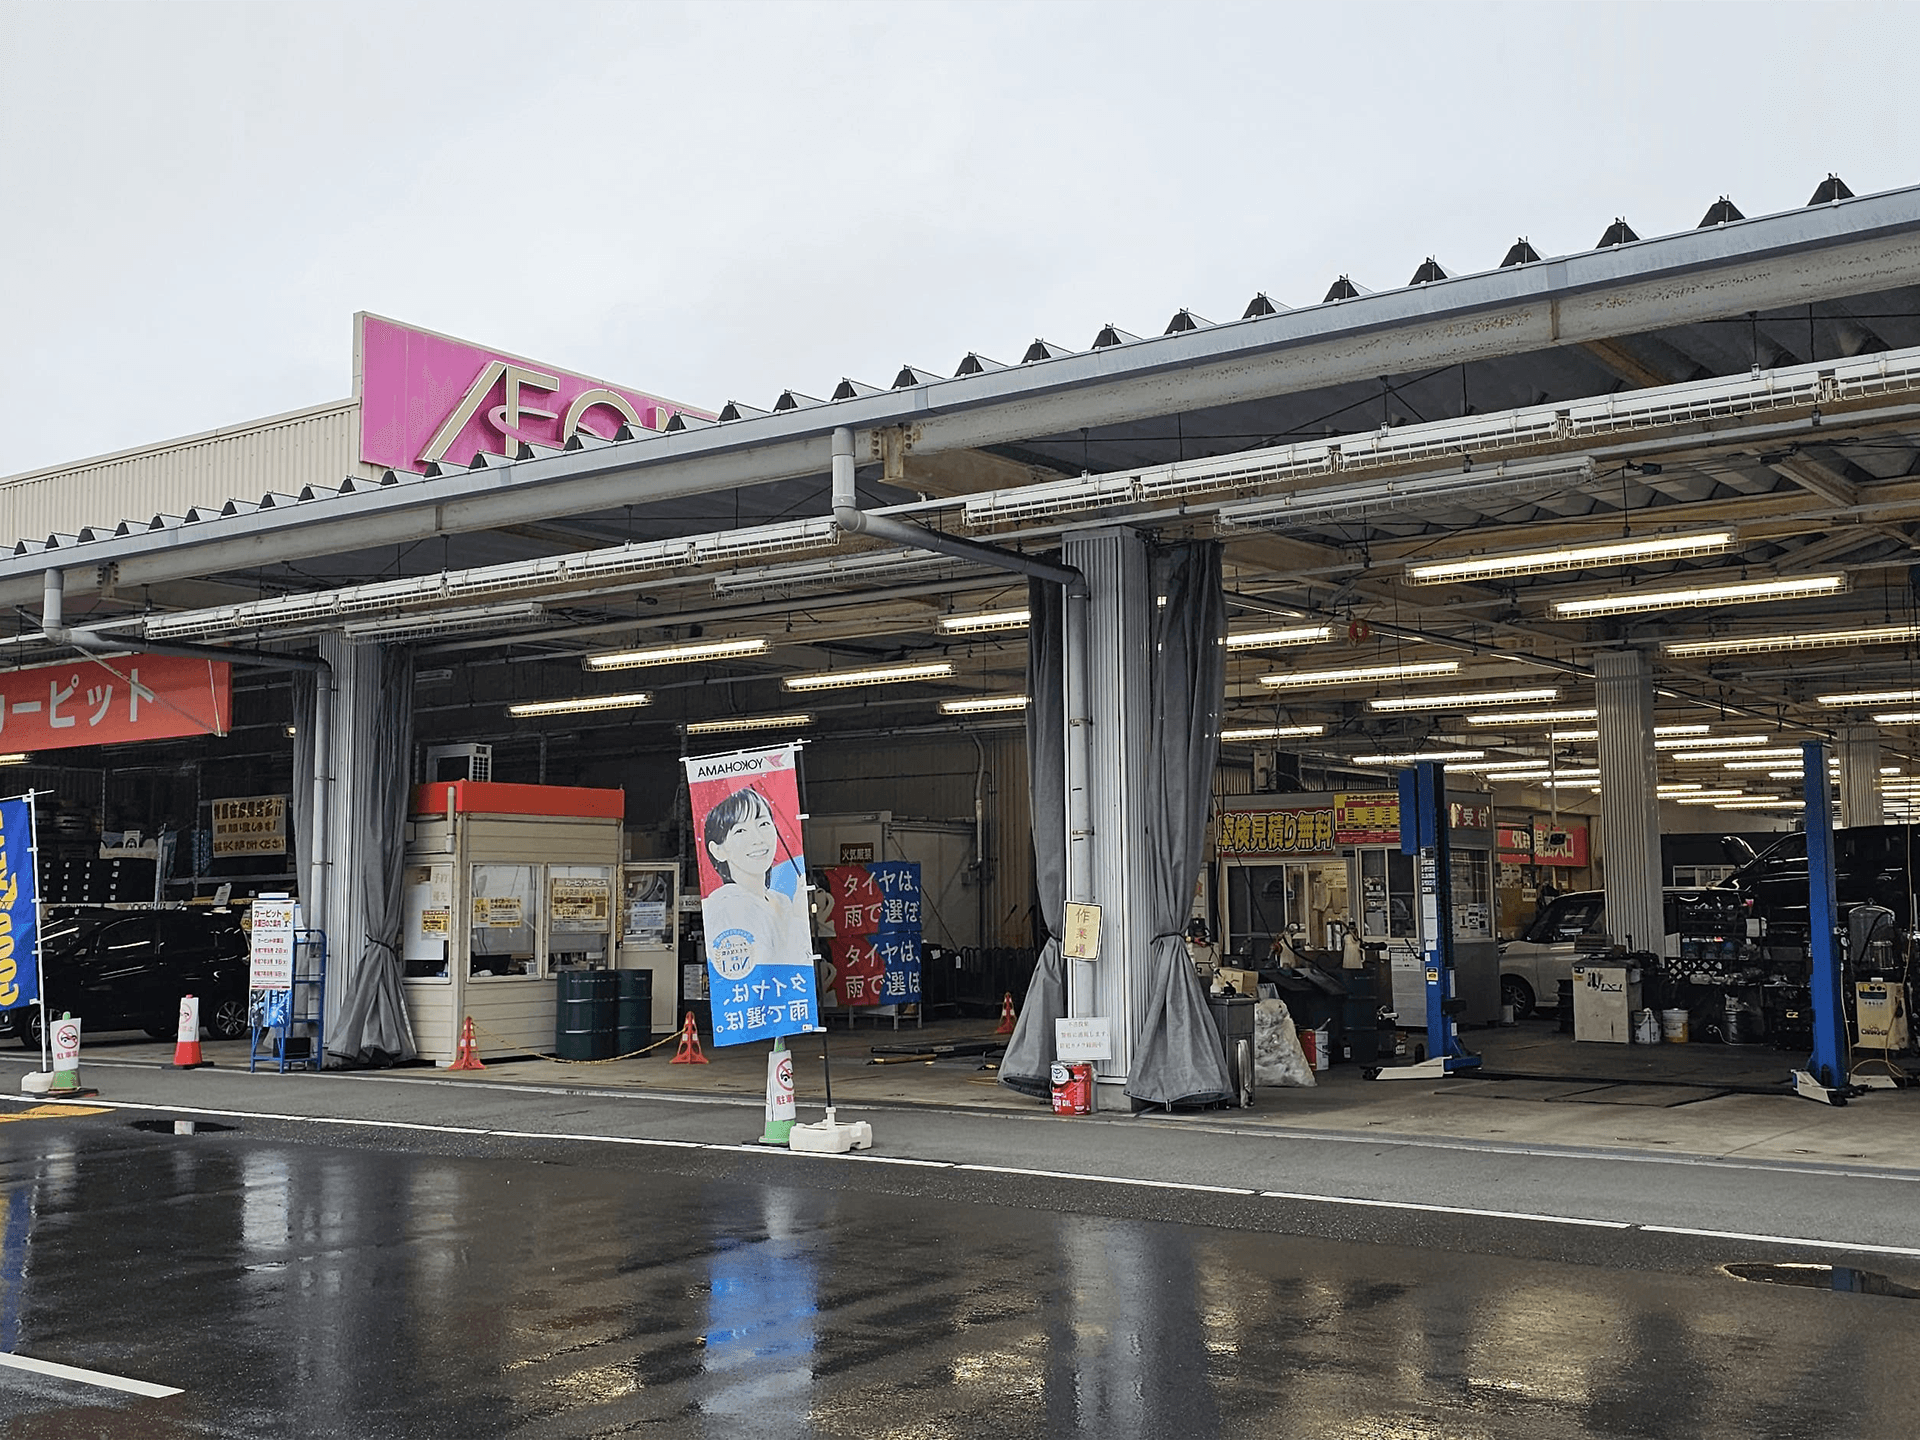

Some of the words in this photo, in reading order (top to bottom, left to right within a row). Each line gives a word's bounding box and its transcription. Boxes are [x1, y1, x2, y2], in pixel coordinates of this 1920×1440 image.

[0, 669, 155, 734] ーピット
[1218, 811, 1333, 852] 車検見積り無料
[844, 870, 919, 897] タイヤは、
[254, 909, 282, 918] カーピット
[846, 940, 921, 968] タイヤは、
